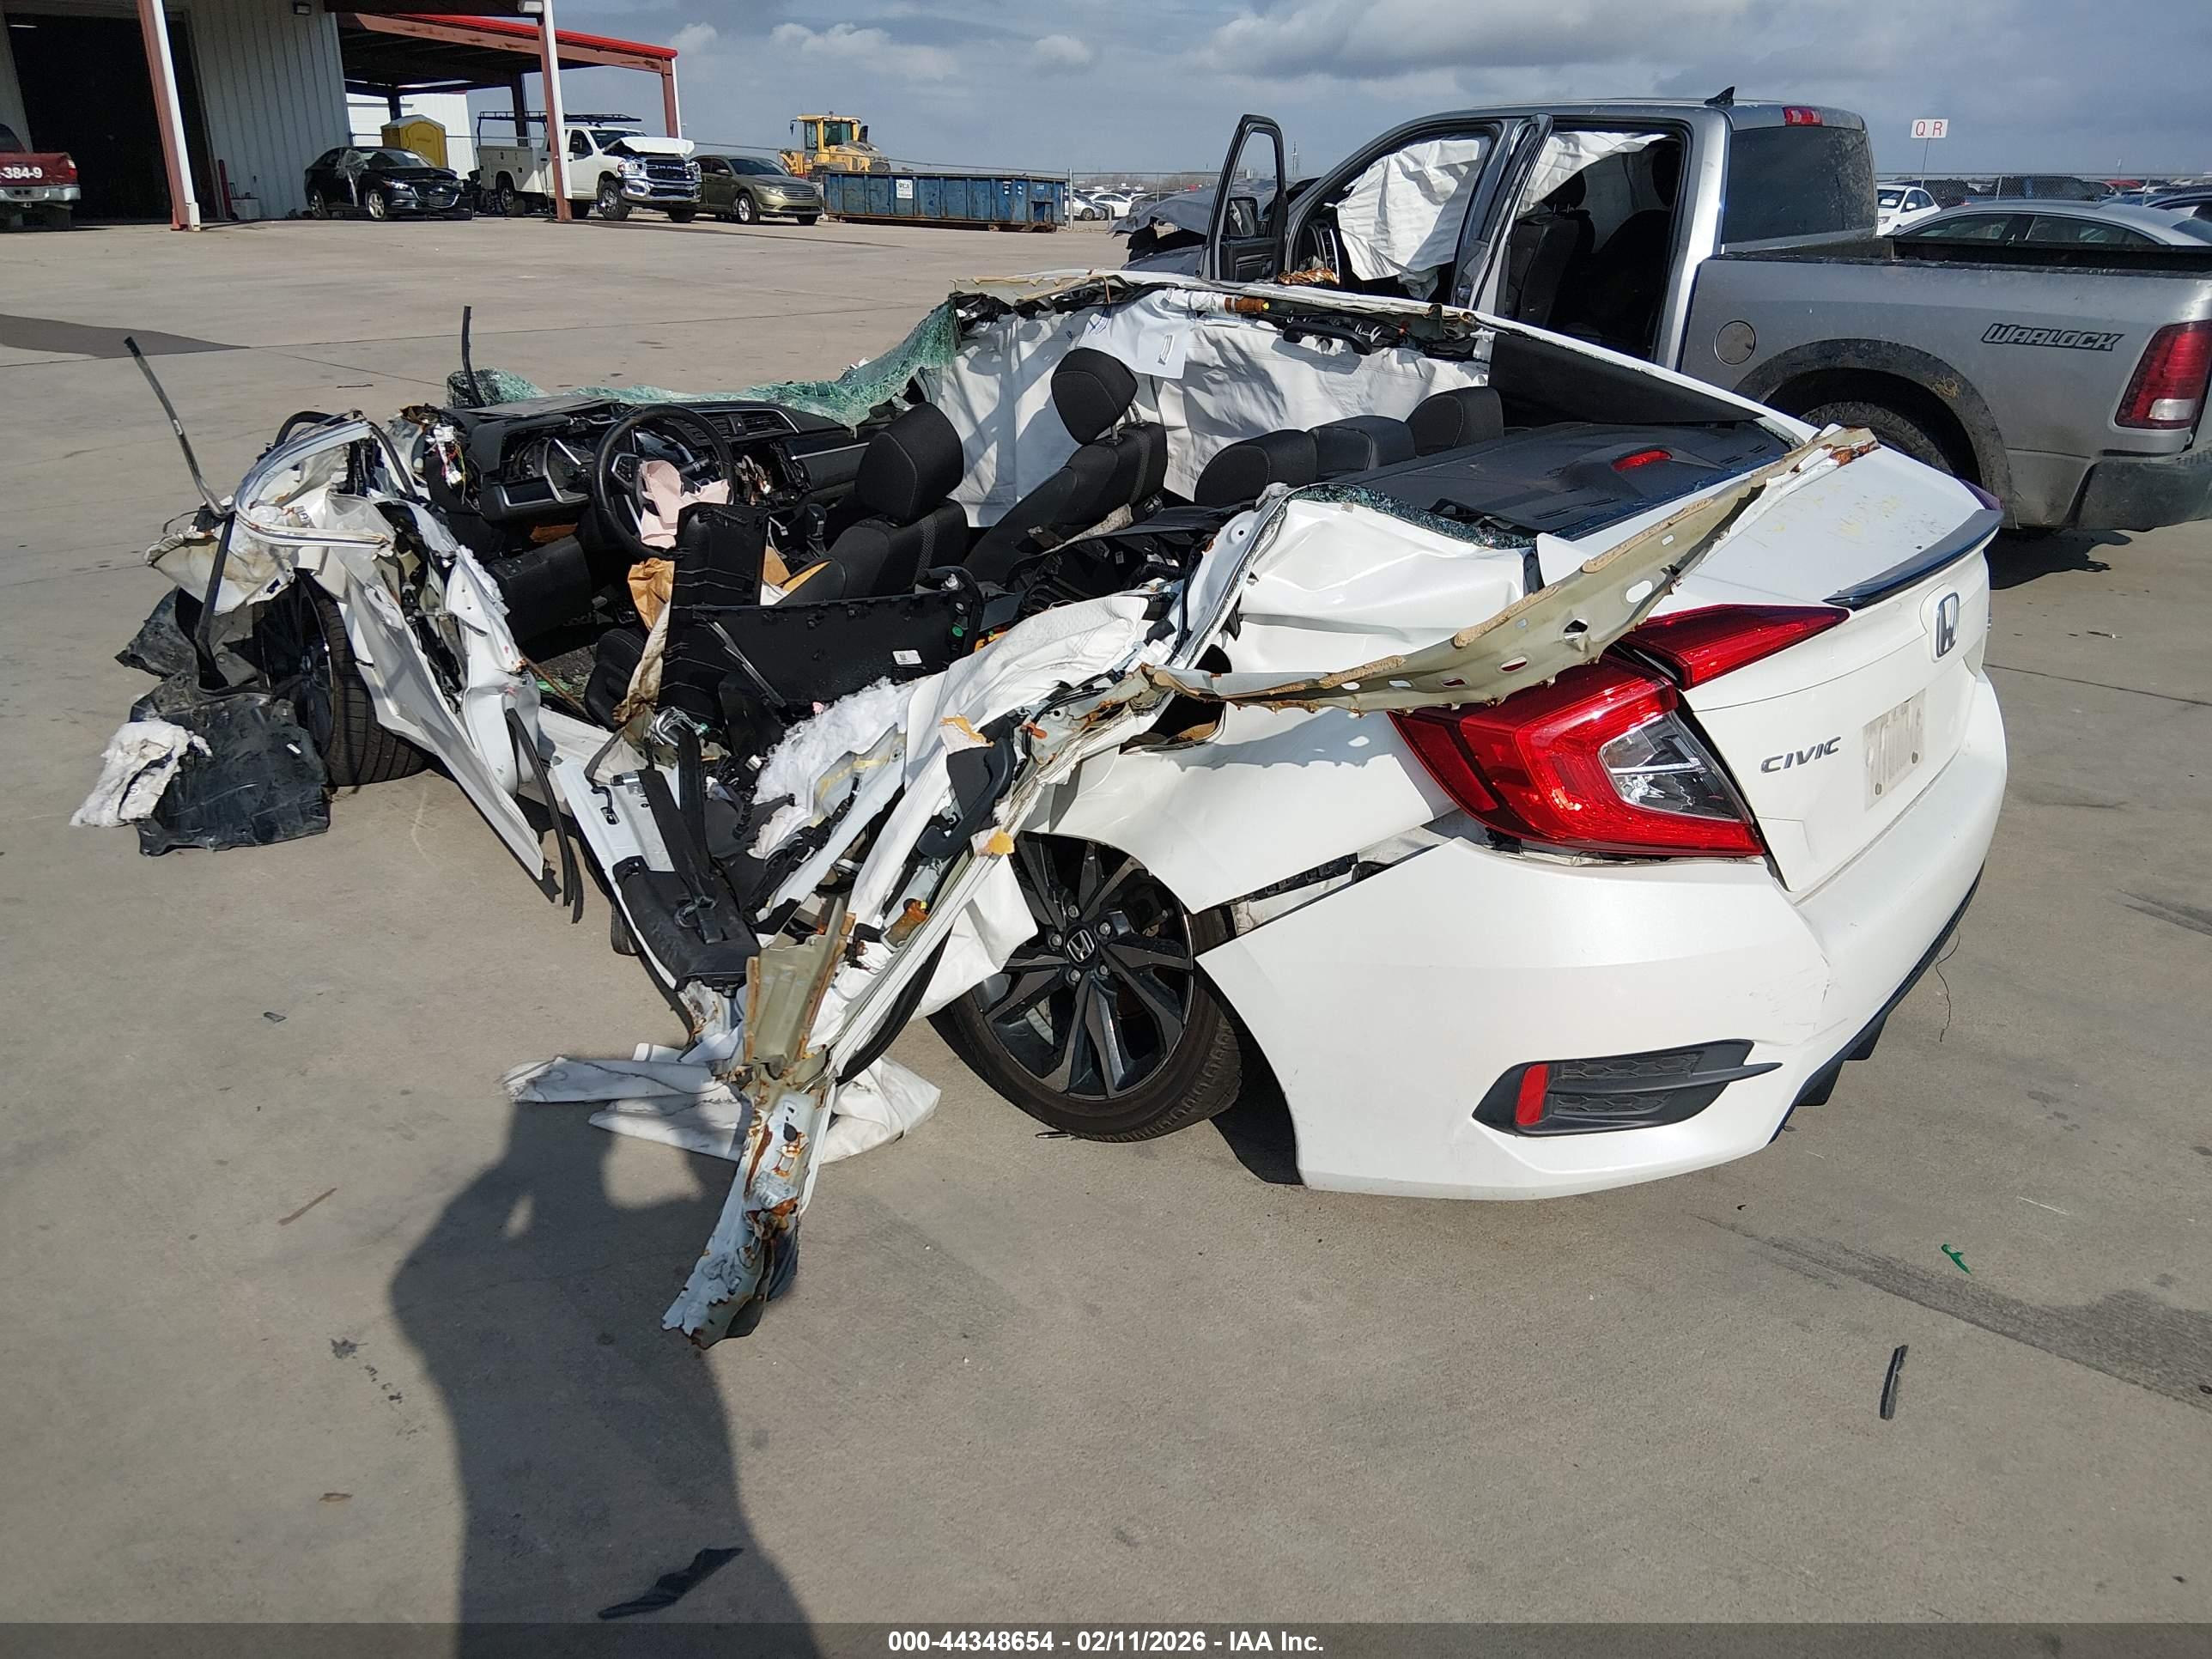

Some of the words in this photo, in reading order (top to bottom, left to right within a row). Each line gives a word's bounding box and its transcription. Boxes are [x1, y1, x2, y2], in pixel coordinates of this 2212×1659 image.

[1916, 121, 1926, 137] Q
[1933, 121, 1943, 137] R
[1981, 323, 2124, 351] WARLOCK
[1760, 736, 1842, 774] CIVIC
